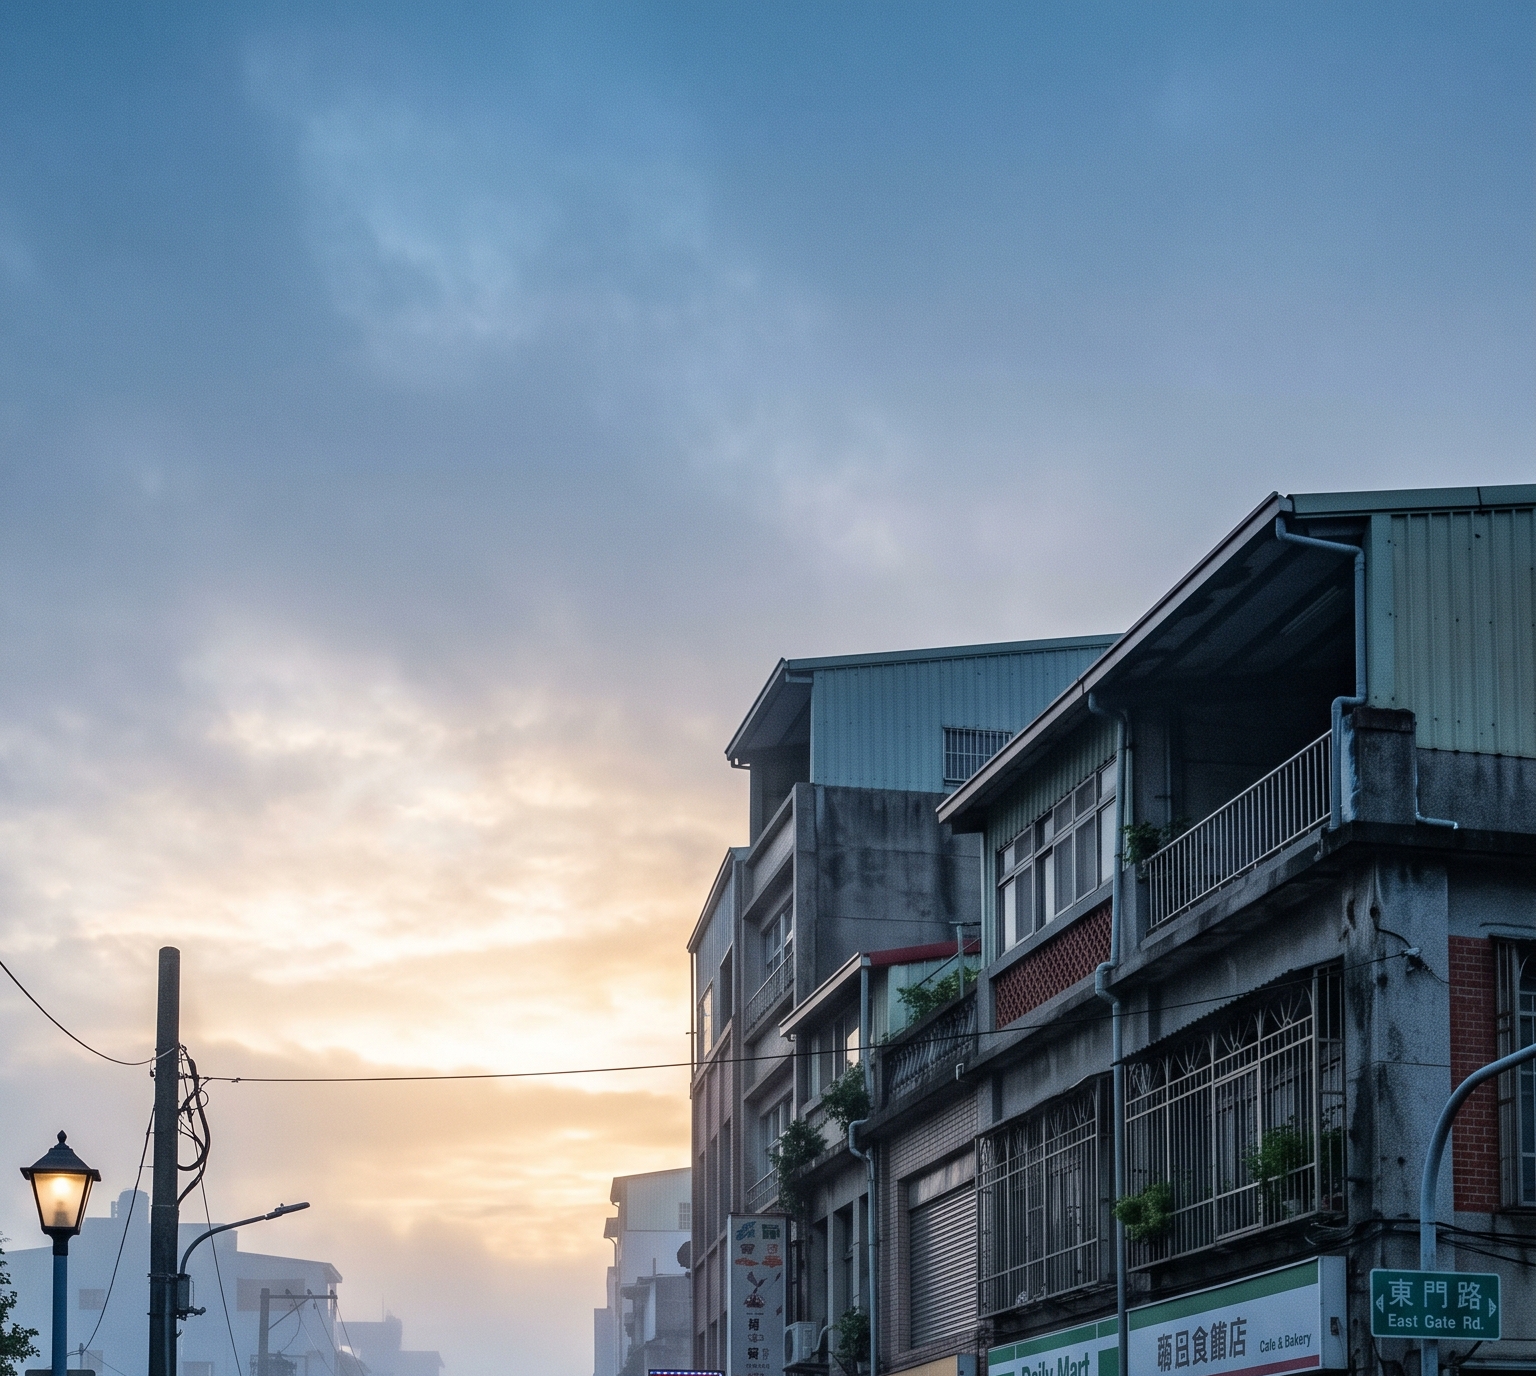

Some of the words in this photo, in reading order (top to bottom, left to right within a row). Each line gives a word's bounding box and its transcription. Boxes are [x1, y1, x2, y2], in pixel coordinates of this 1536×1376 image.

[1388, 1278, 1482, 1310] 東門路
[1388, 1313, 1418, 1328] East
[1424, 1314, 1457, 1329] Gate
[1463, 1316, 1485, 1330] Rd.
[1277, 1336, 1284, 1350] &
[1284, 1332, 1312, 1348] Bakery
